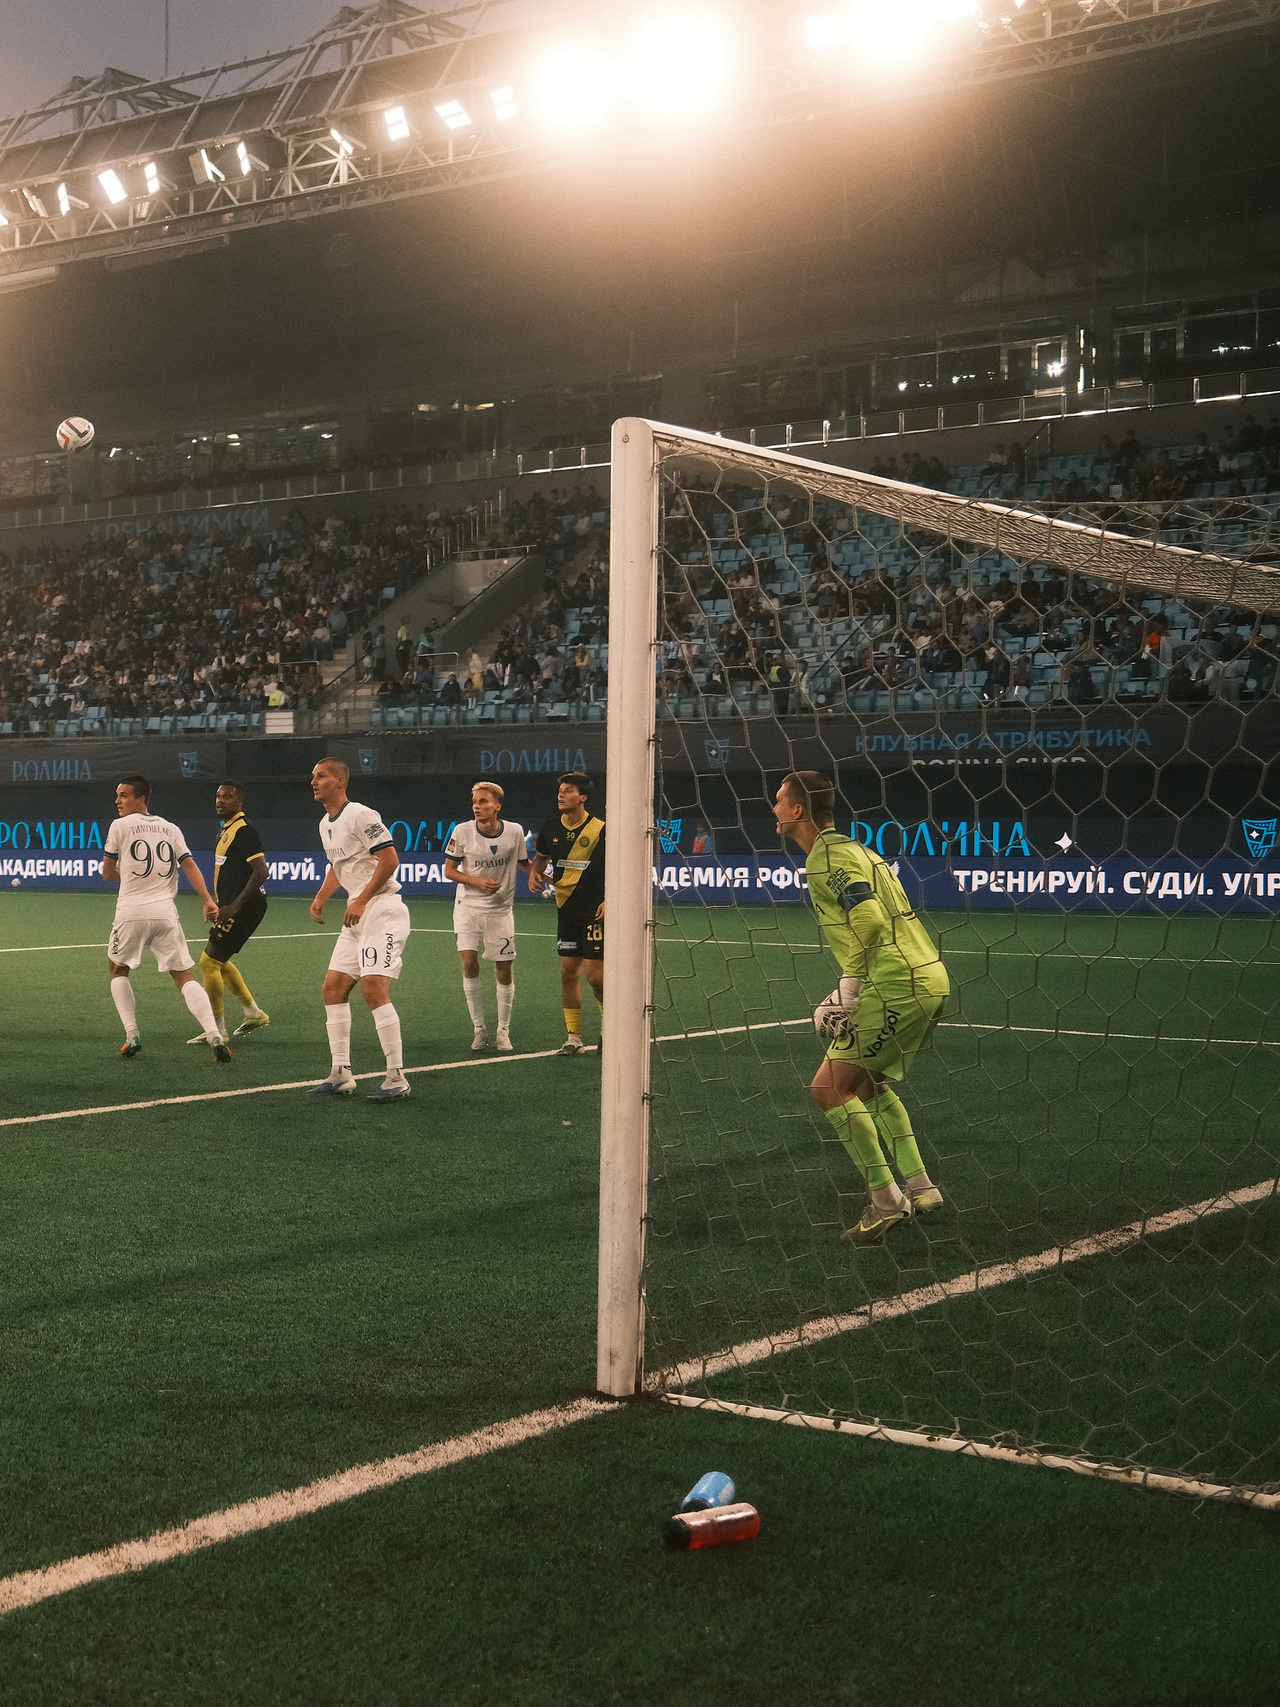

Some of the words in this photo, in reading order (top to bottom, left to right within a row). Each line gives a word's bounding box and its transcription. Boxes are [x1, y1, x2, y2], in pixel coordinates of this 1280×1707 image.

[855, 732, 969, 751] КЛУБНАЯ
[977, 728, 1152, 750] АТРИБУТИКА
[130, 839, 177, 880] 99
[756, 866, 808, 889] РФС
[361, 946, 378, 968] 19
[383, 932, 394, 969] Vorgol
[863, 1008, 901, 1058] Vorgol
